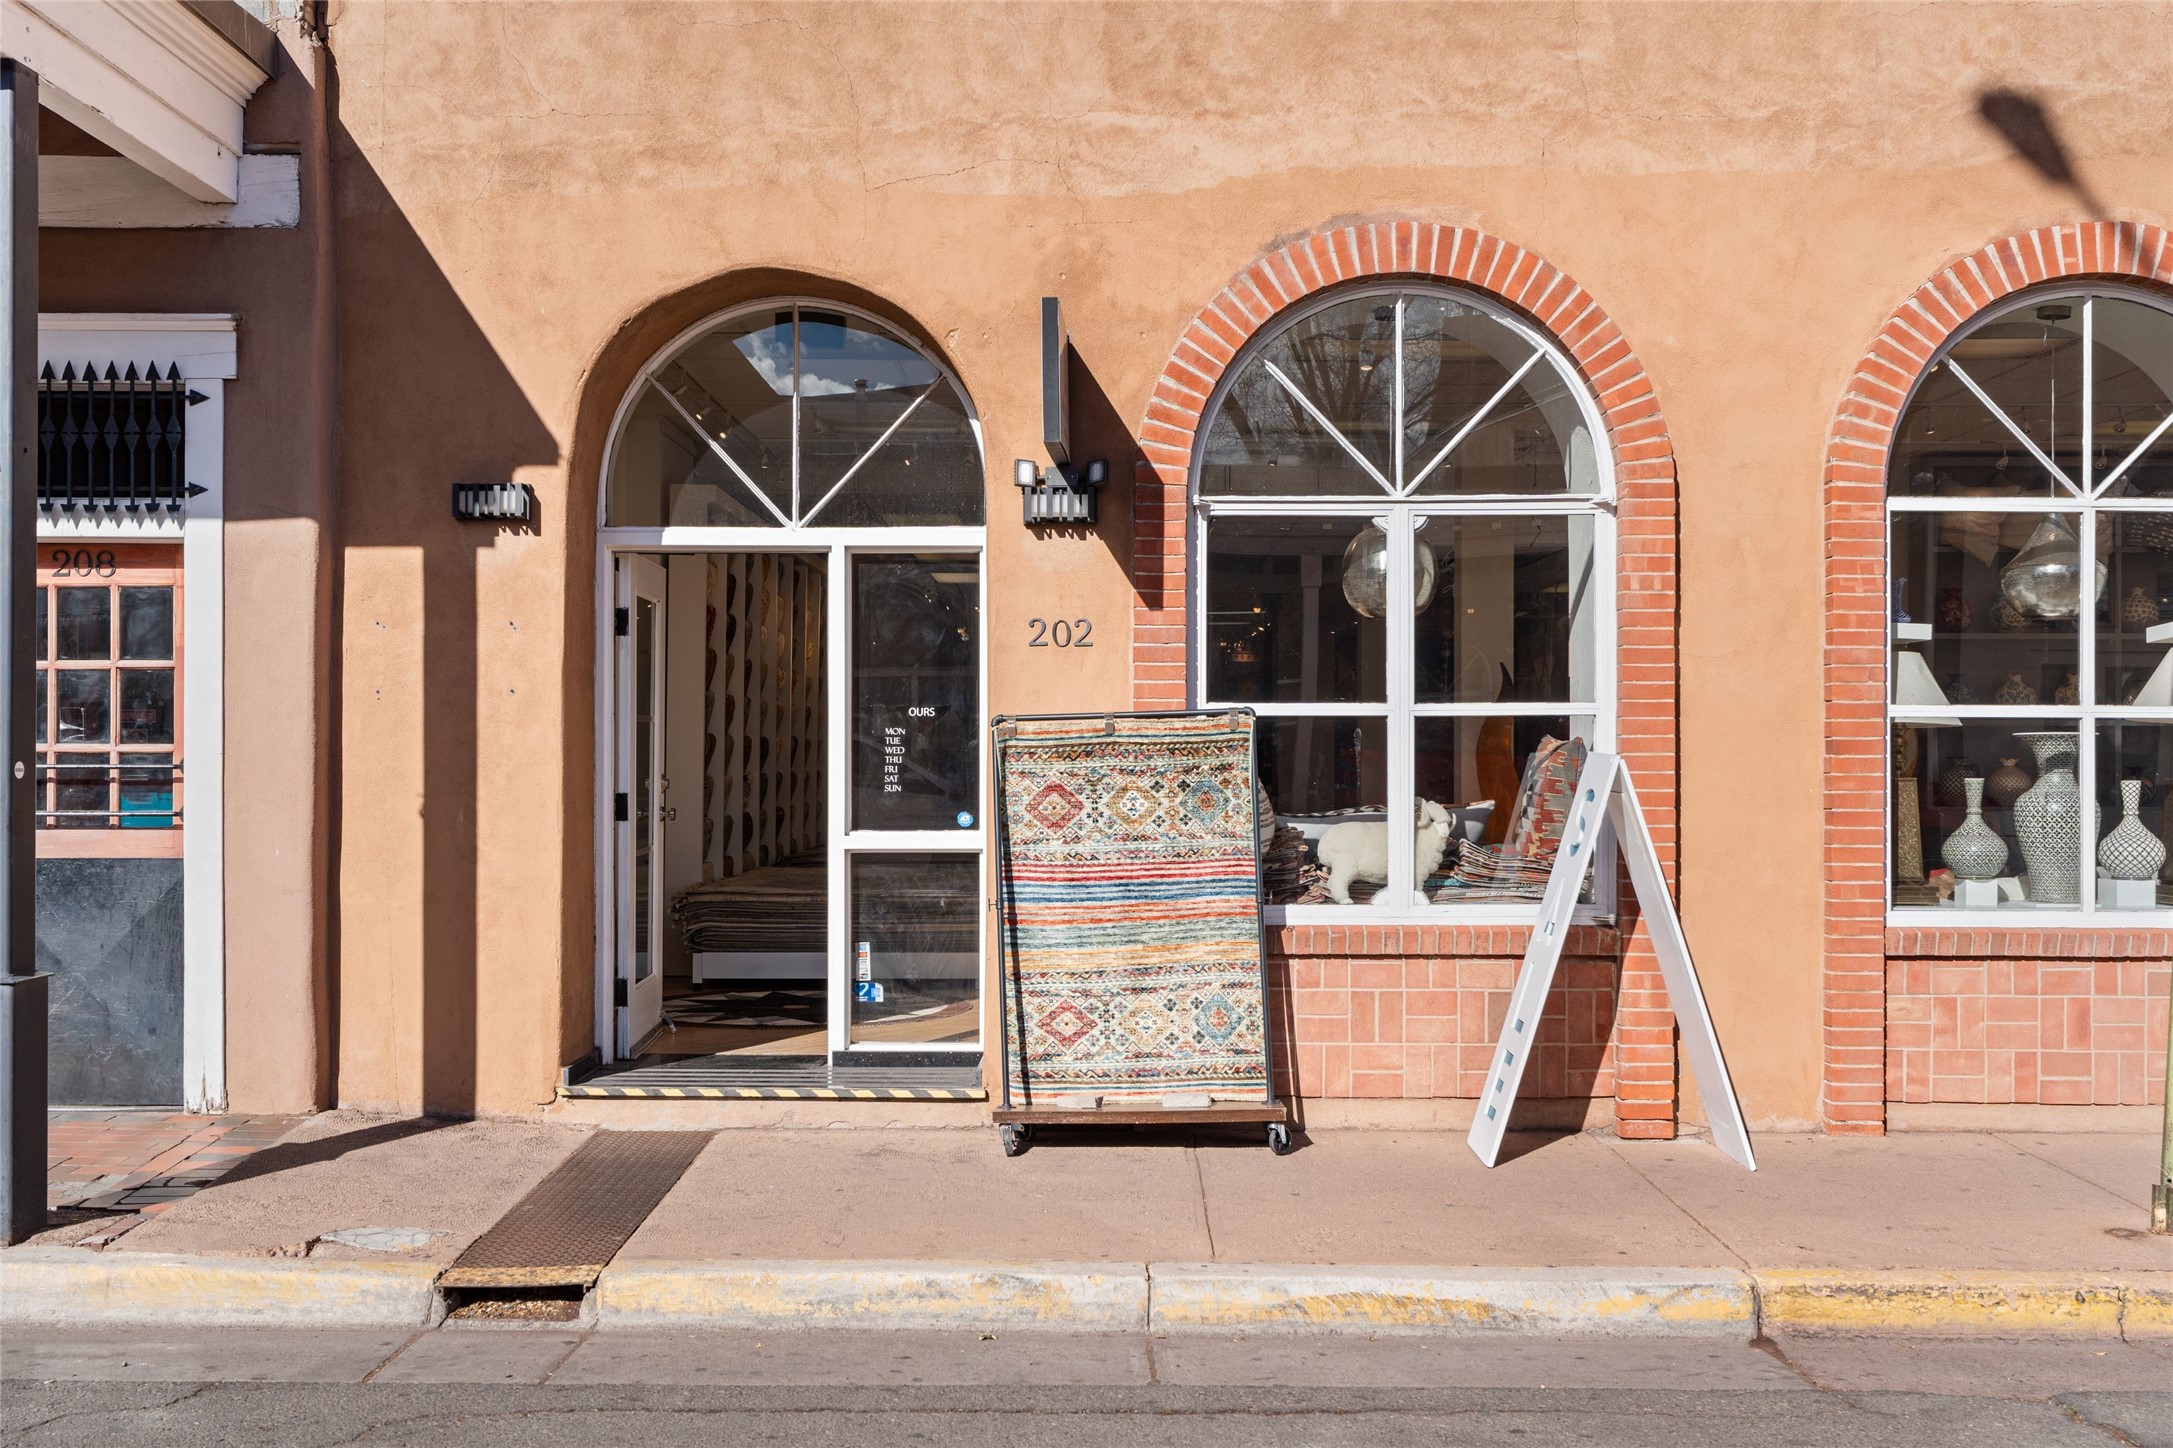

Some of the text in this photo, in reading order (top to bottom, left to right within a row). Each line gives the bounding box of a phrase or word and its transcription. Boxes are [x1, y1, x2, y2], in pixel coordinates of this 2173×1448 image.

[51, 548, 117, 579] 208
[1028, 618, 1094, 648] 202
[908, 706, 936, 717] OURS
[884, 727, 906, 736] MON
[884, 737, 901, 745] TUE
[884, 746, 905, 755] WED
[884, 756, 903, 764] THU
[884, 765, 898, 774] FRI
[884, 775, 899, 783] SAT
[884, 784, 902, 793] SUN
